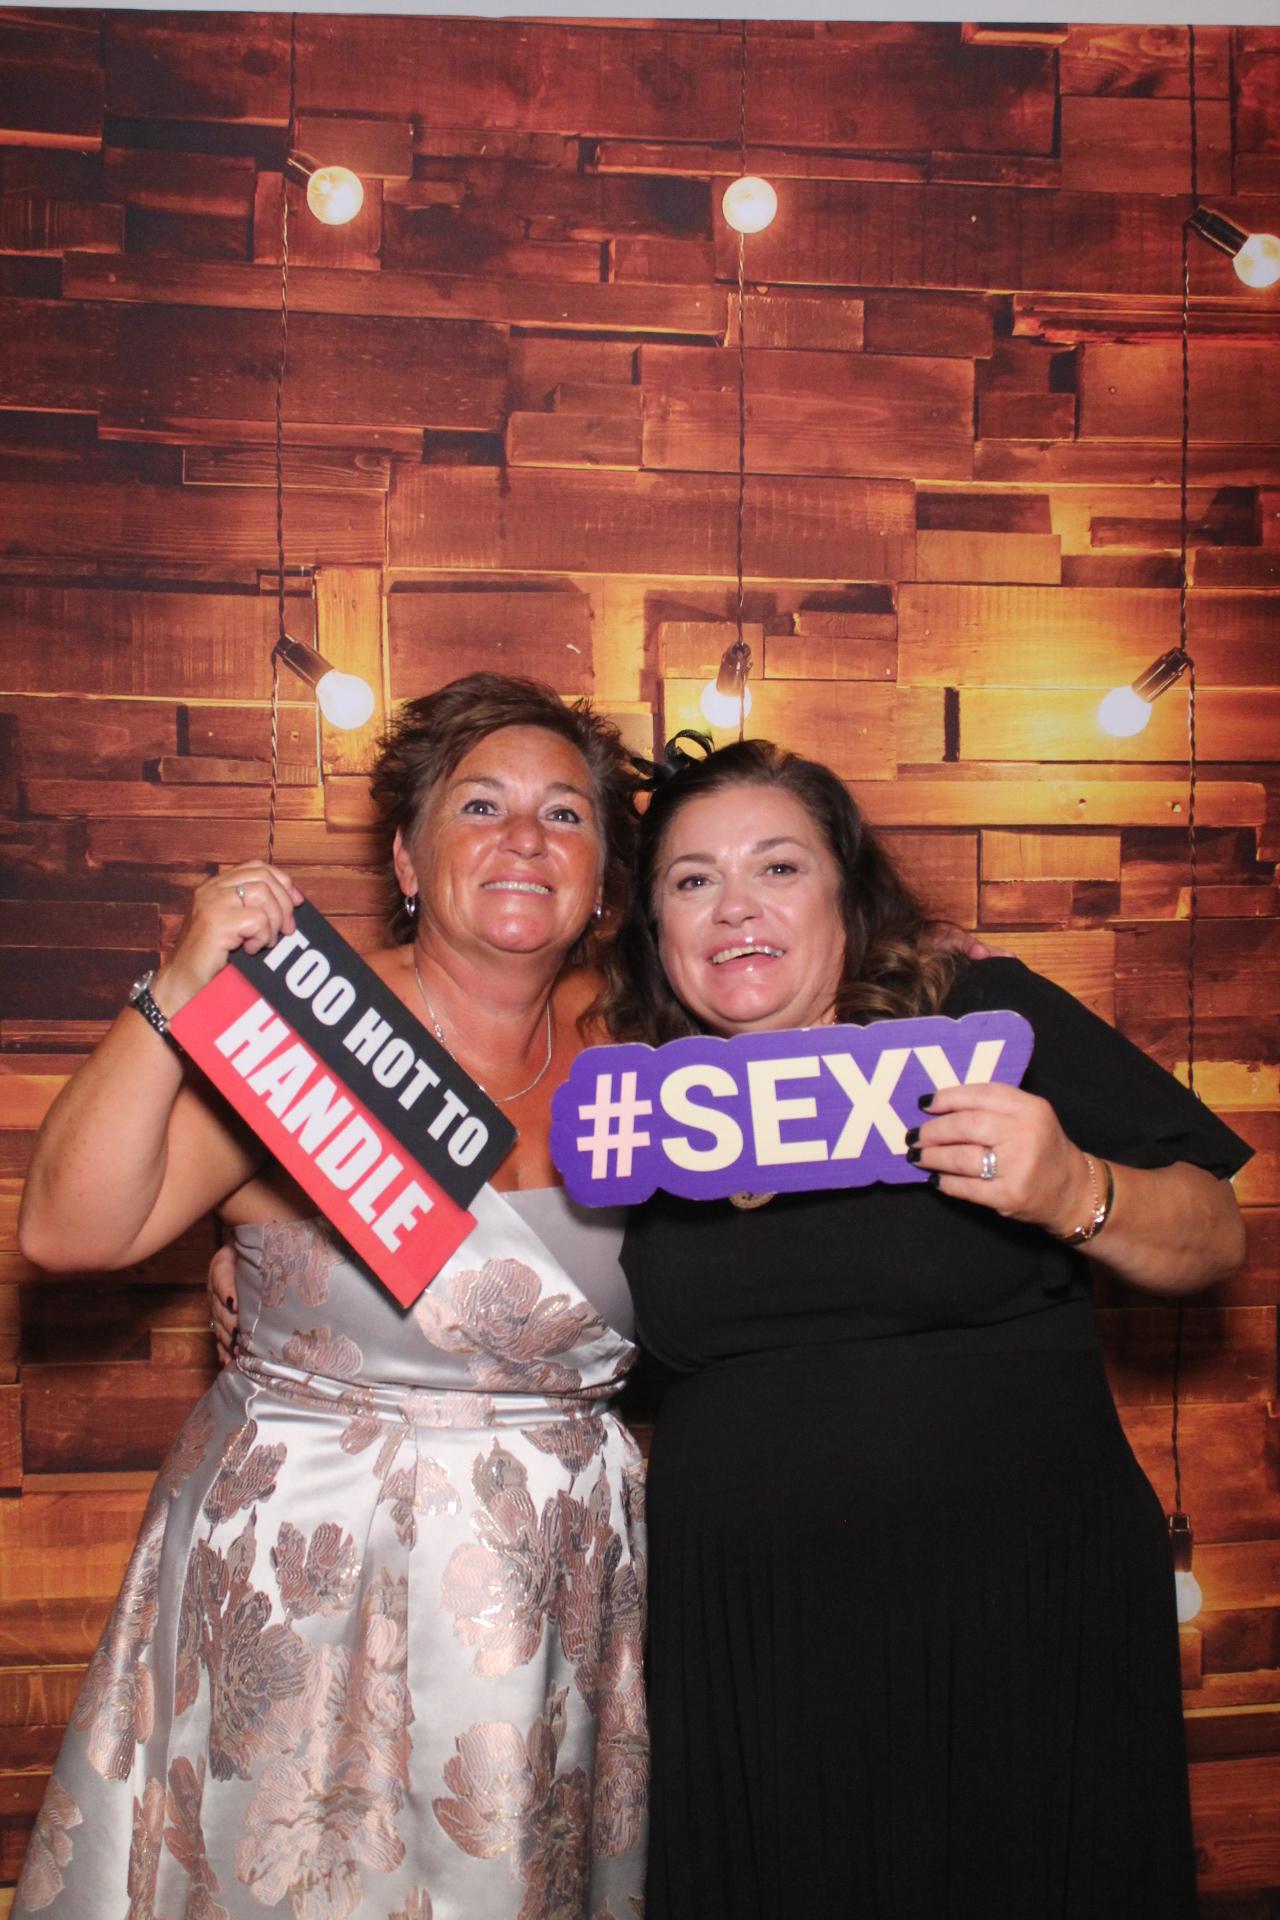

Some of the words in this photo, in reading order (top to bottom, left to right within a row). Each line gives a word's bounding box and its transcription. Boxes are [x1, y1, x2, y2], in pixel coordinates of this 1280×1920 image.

[213, 998, 434, 1254] HANDLE
[263, 928, 356, 1026] TOO
[342, 1007, 441, 1111] HOT
[427, 1089, 490, 1167] TO
